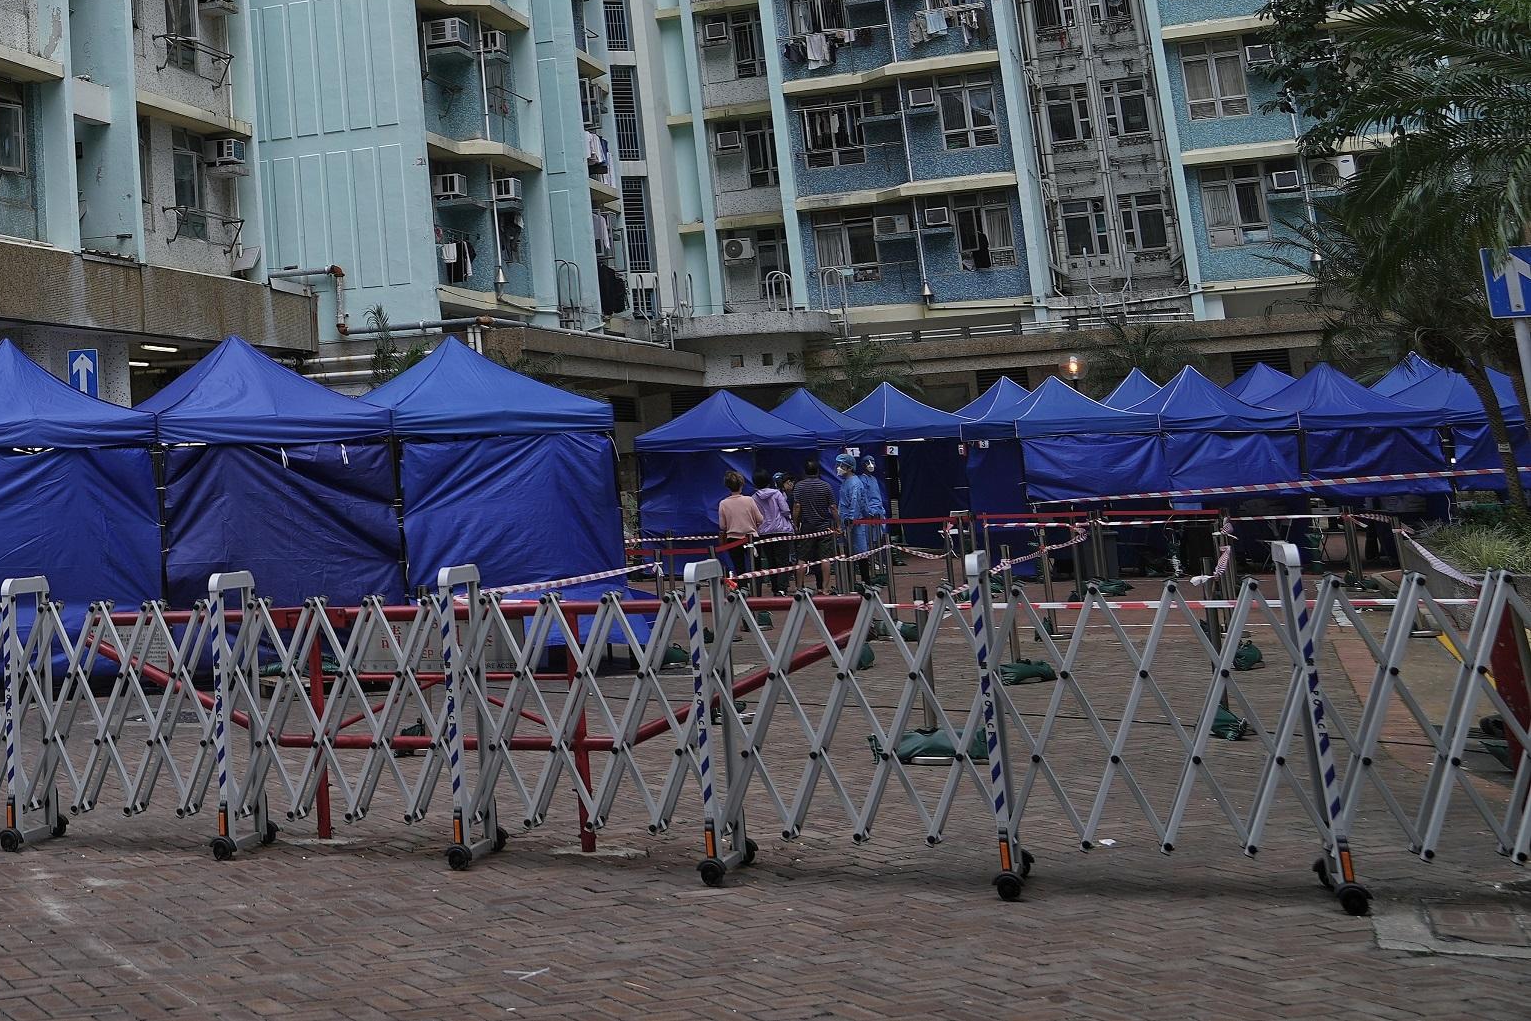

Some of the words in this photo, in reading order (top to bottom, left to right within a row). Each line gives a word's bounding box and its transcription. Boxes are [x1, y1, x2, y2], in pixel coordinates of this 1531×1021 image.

[889, 446, 894, 454] 2
[447, 689, 456, 727] POCE
[695, 691, 705, 733] POCE
[983, 692, 996, 736] POCE
[1310, 690, 1328, 737] POCE
